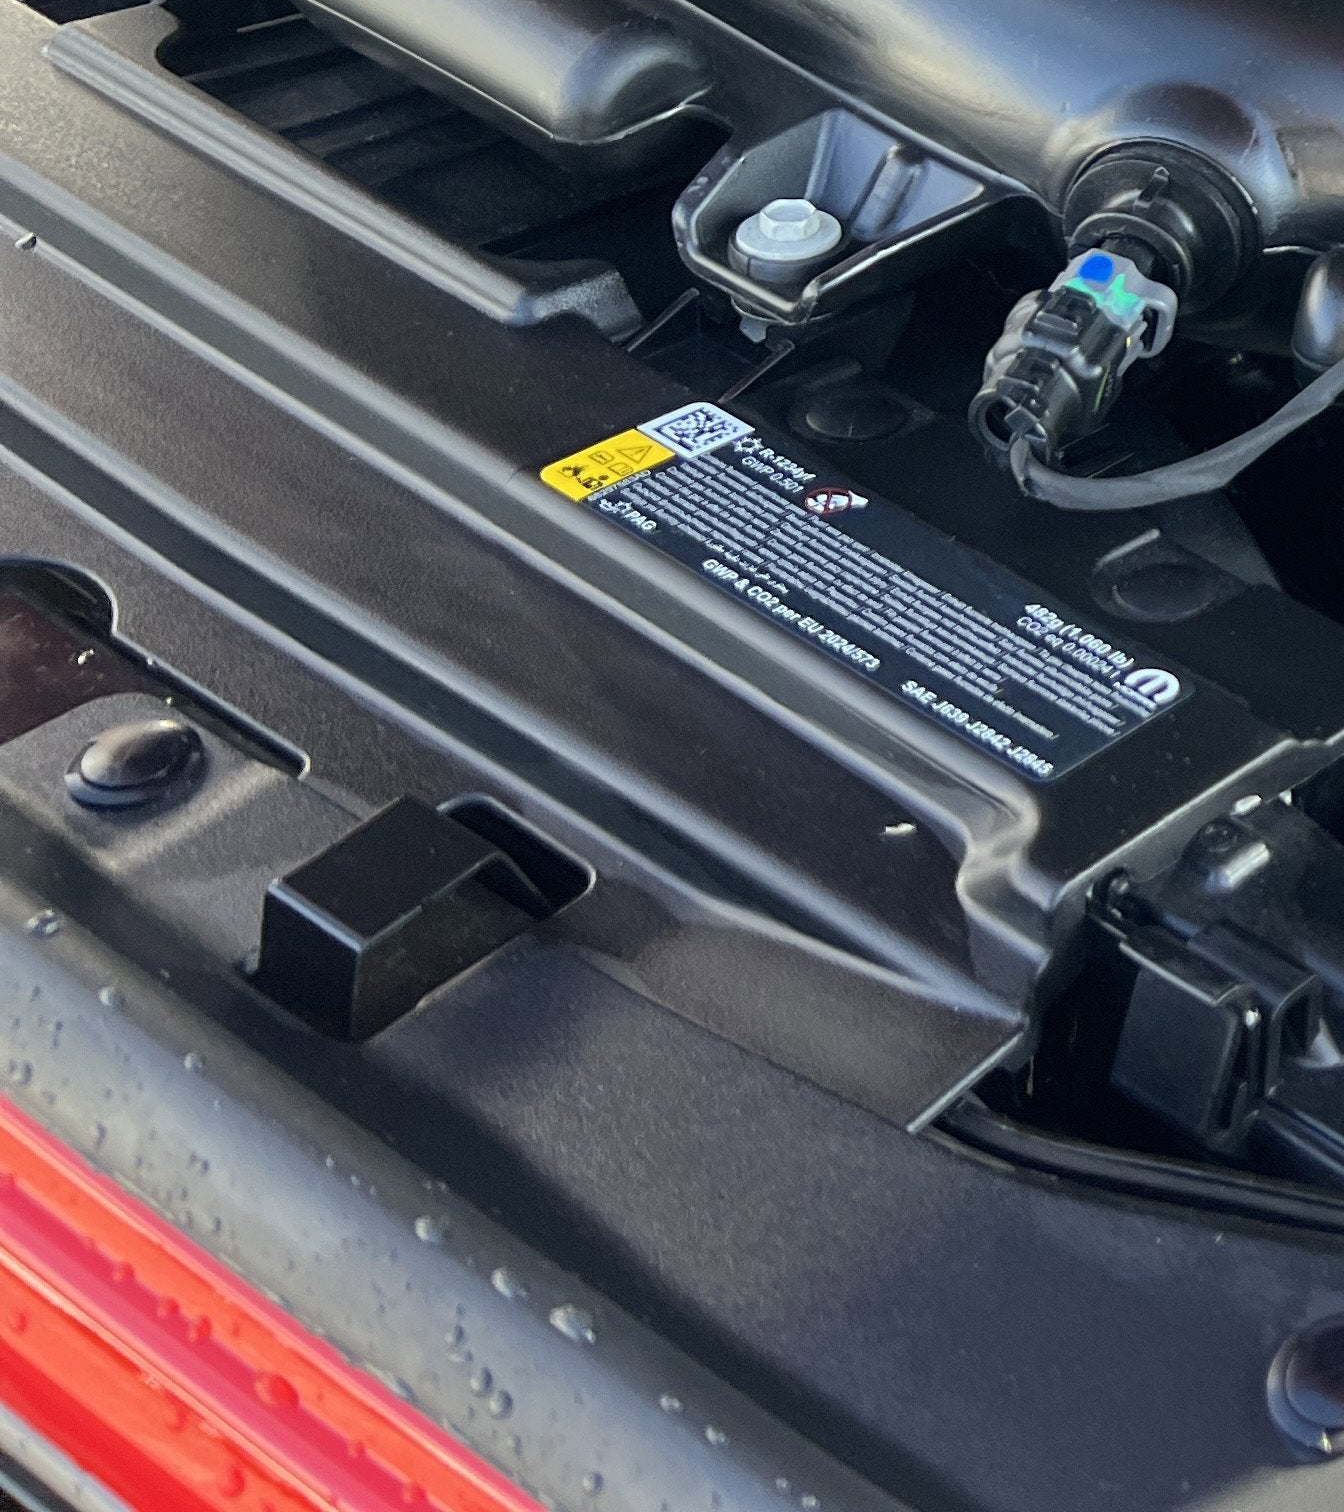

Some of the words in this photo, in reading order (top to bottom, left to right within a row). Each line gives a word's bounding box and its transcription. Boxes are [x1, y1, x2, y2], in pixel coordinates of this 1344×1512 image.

[741, 456, 775, 474] GWP
[769, 472, 804, 493] 0.501
[759, 448, 817, 481] R-1234yf
[624, 510, 658, 531] PAG
[702, 558, 739, 582] GWP
[733, 578, 751, 591] &
[747, 585, 780, 608] CO2
[771, 604, 802, 621] per
[797, 616, 825, 634] EU
[817, 629, 881, 671] 2024/573
[1016, 616, 1050, 637] CO2
[901, 680, 938, 706] SAE
[931, 701, 970, 726] J639
[965, 720, 1012, 752] J2842
[1006, 746, 1054, 778] J2845
